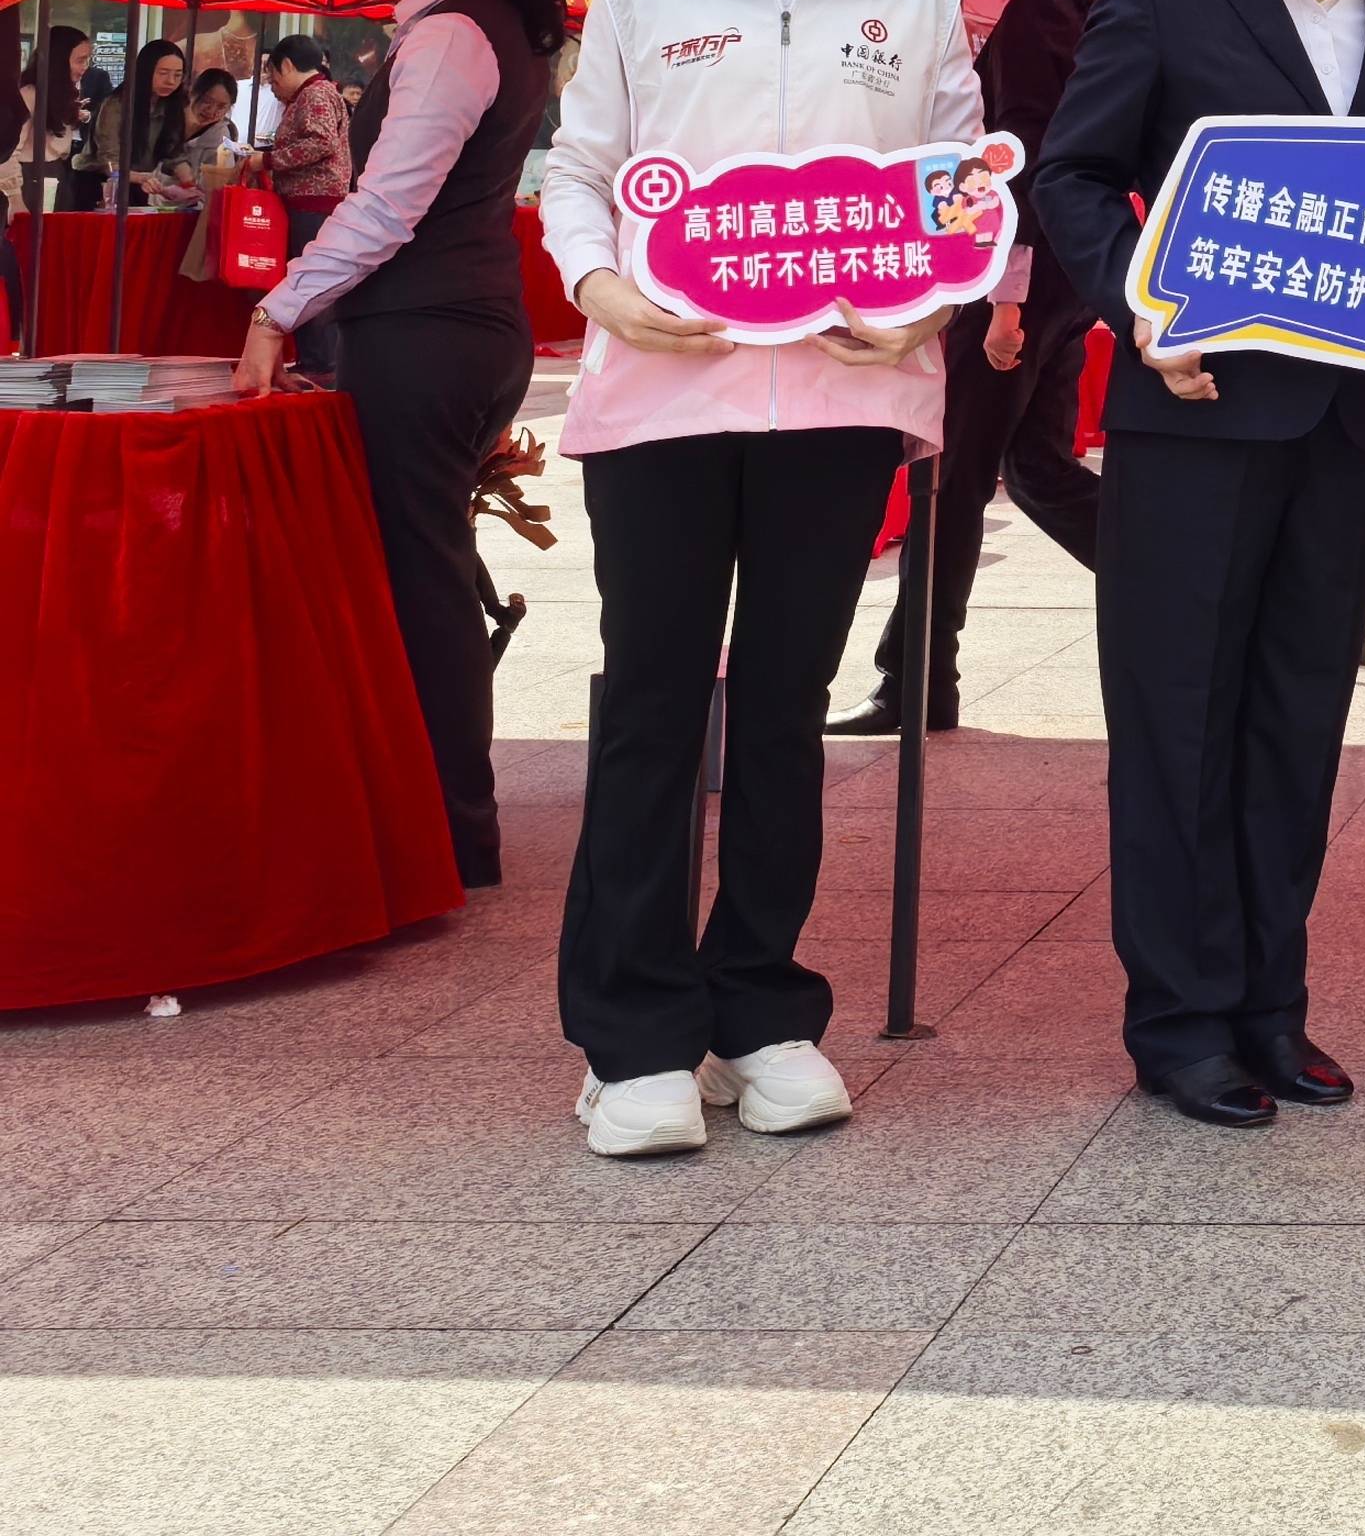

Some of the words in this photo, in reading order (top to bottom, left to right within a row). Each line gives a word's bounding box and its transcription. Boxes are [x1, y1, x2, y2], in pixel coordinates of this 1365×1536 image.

[877, 69, 900, 81] CHINA
[683, 193, 905, 243] 高利高息莫动心
[711, 240, 933, 292] 不听不信不转账
